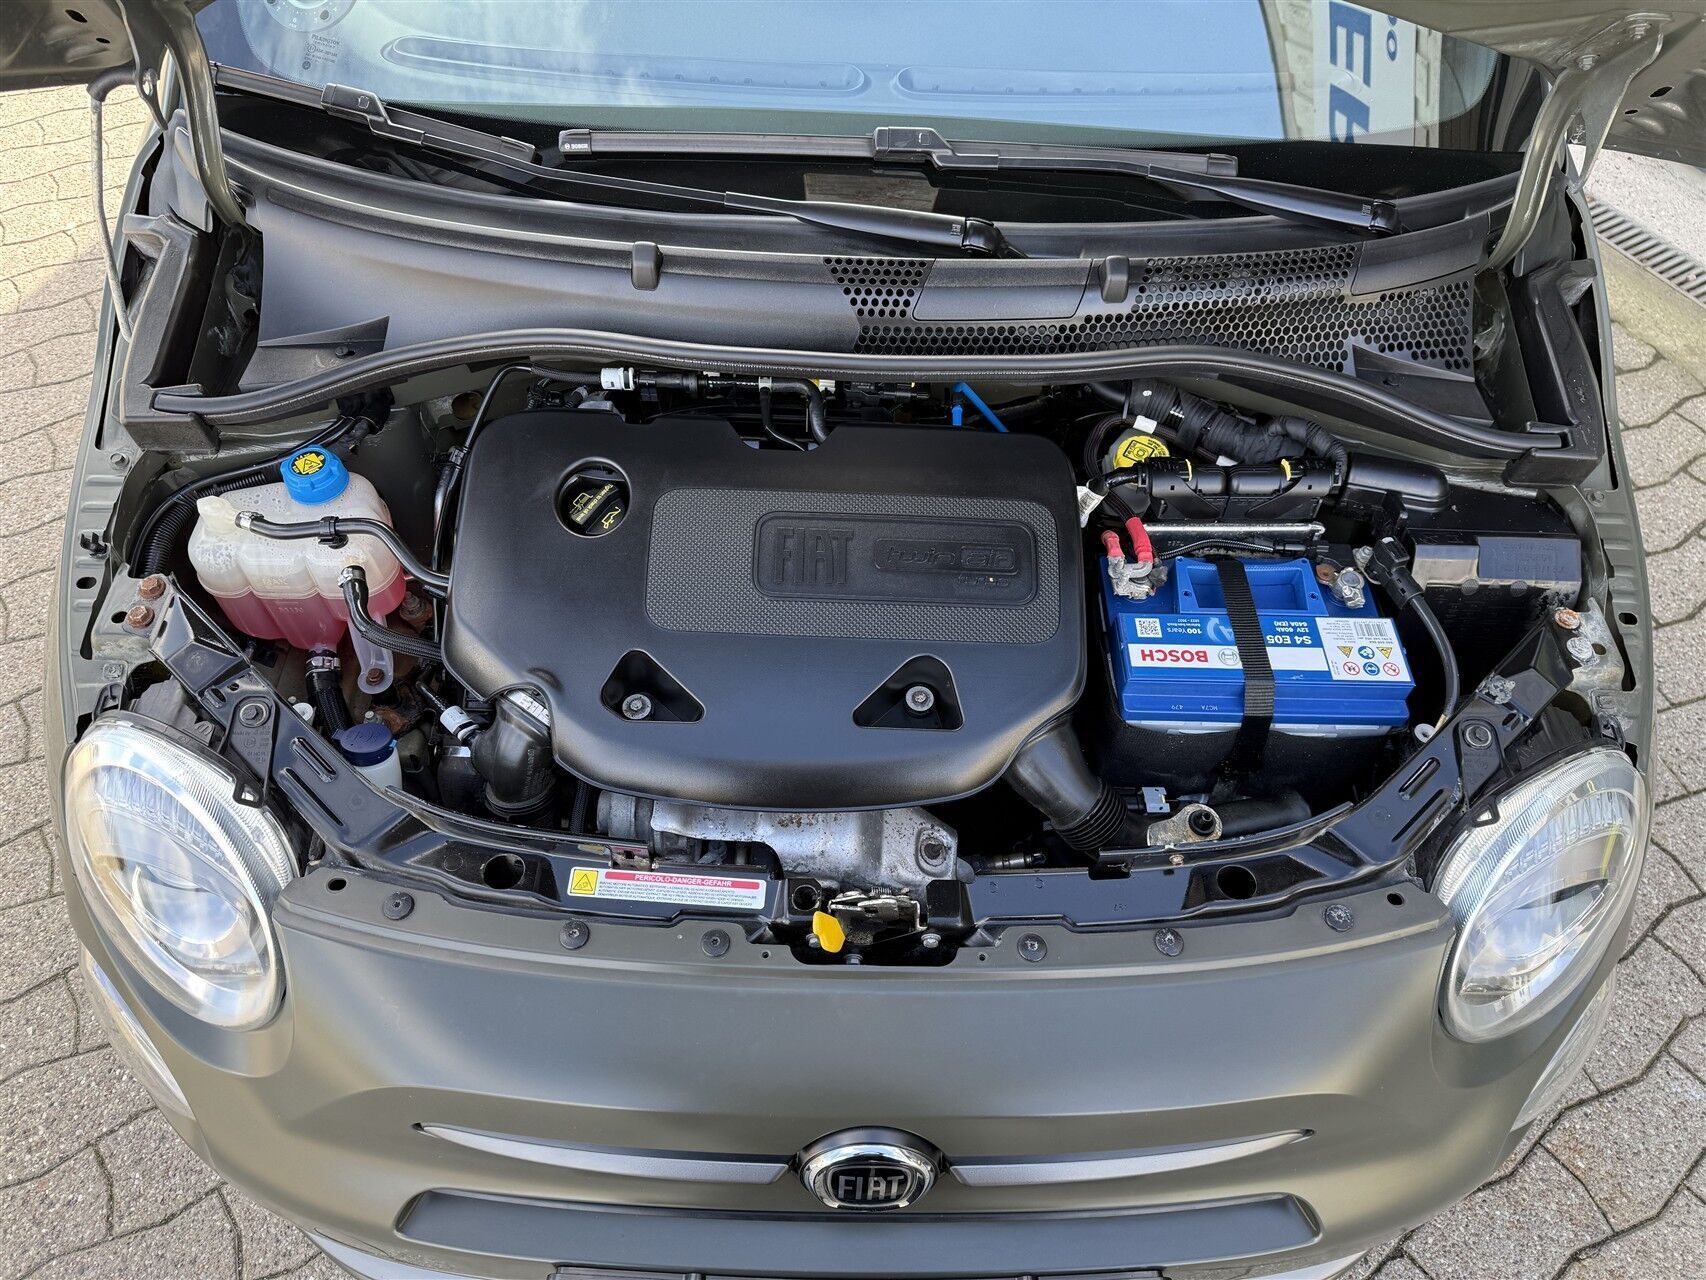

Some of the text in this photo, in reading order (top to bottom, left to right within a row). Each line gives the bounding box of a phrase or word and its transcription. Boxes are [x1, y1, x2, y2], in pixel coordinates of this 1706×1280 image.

[773, 526, 856, 585] FIAT
[1266, 634, 1312, 645] S4 E05
[1140, 648, 1209, 664] BOSCH
[634, 874, 733, 888] PERICOLO-DANGER-GEFAHR
[838, 1174, 904, 1200] FIAT
